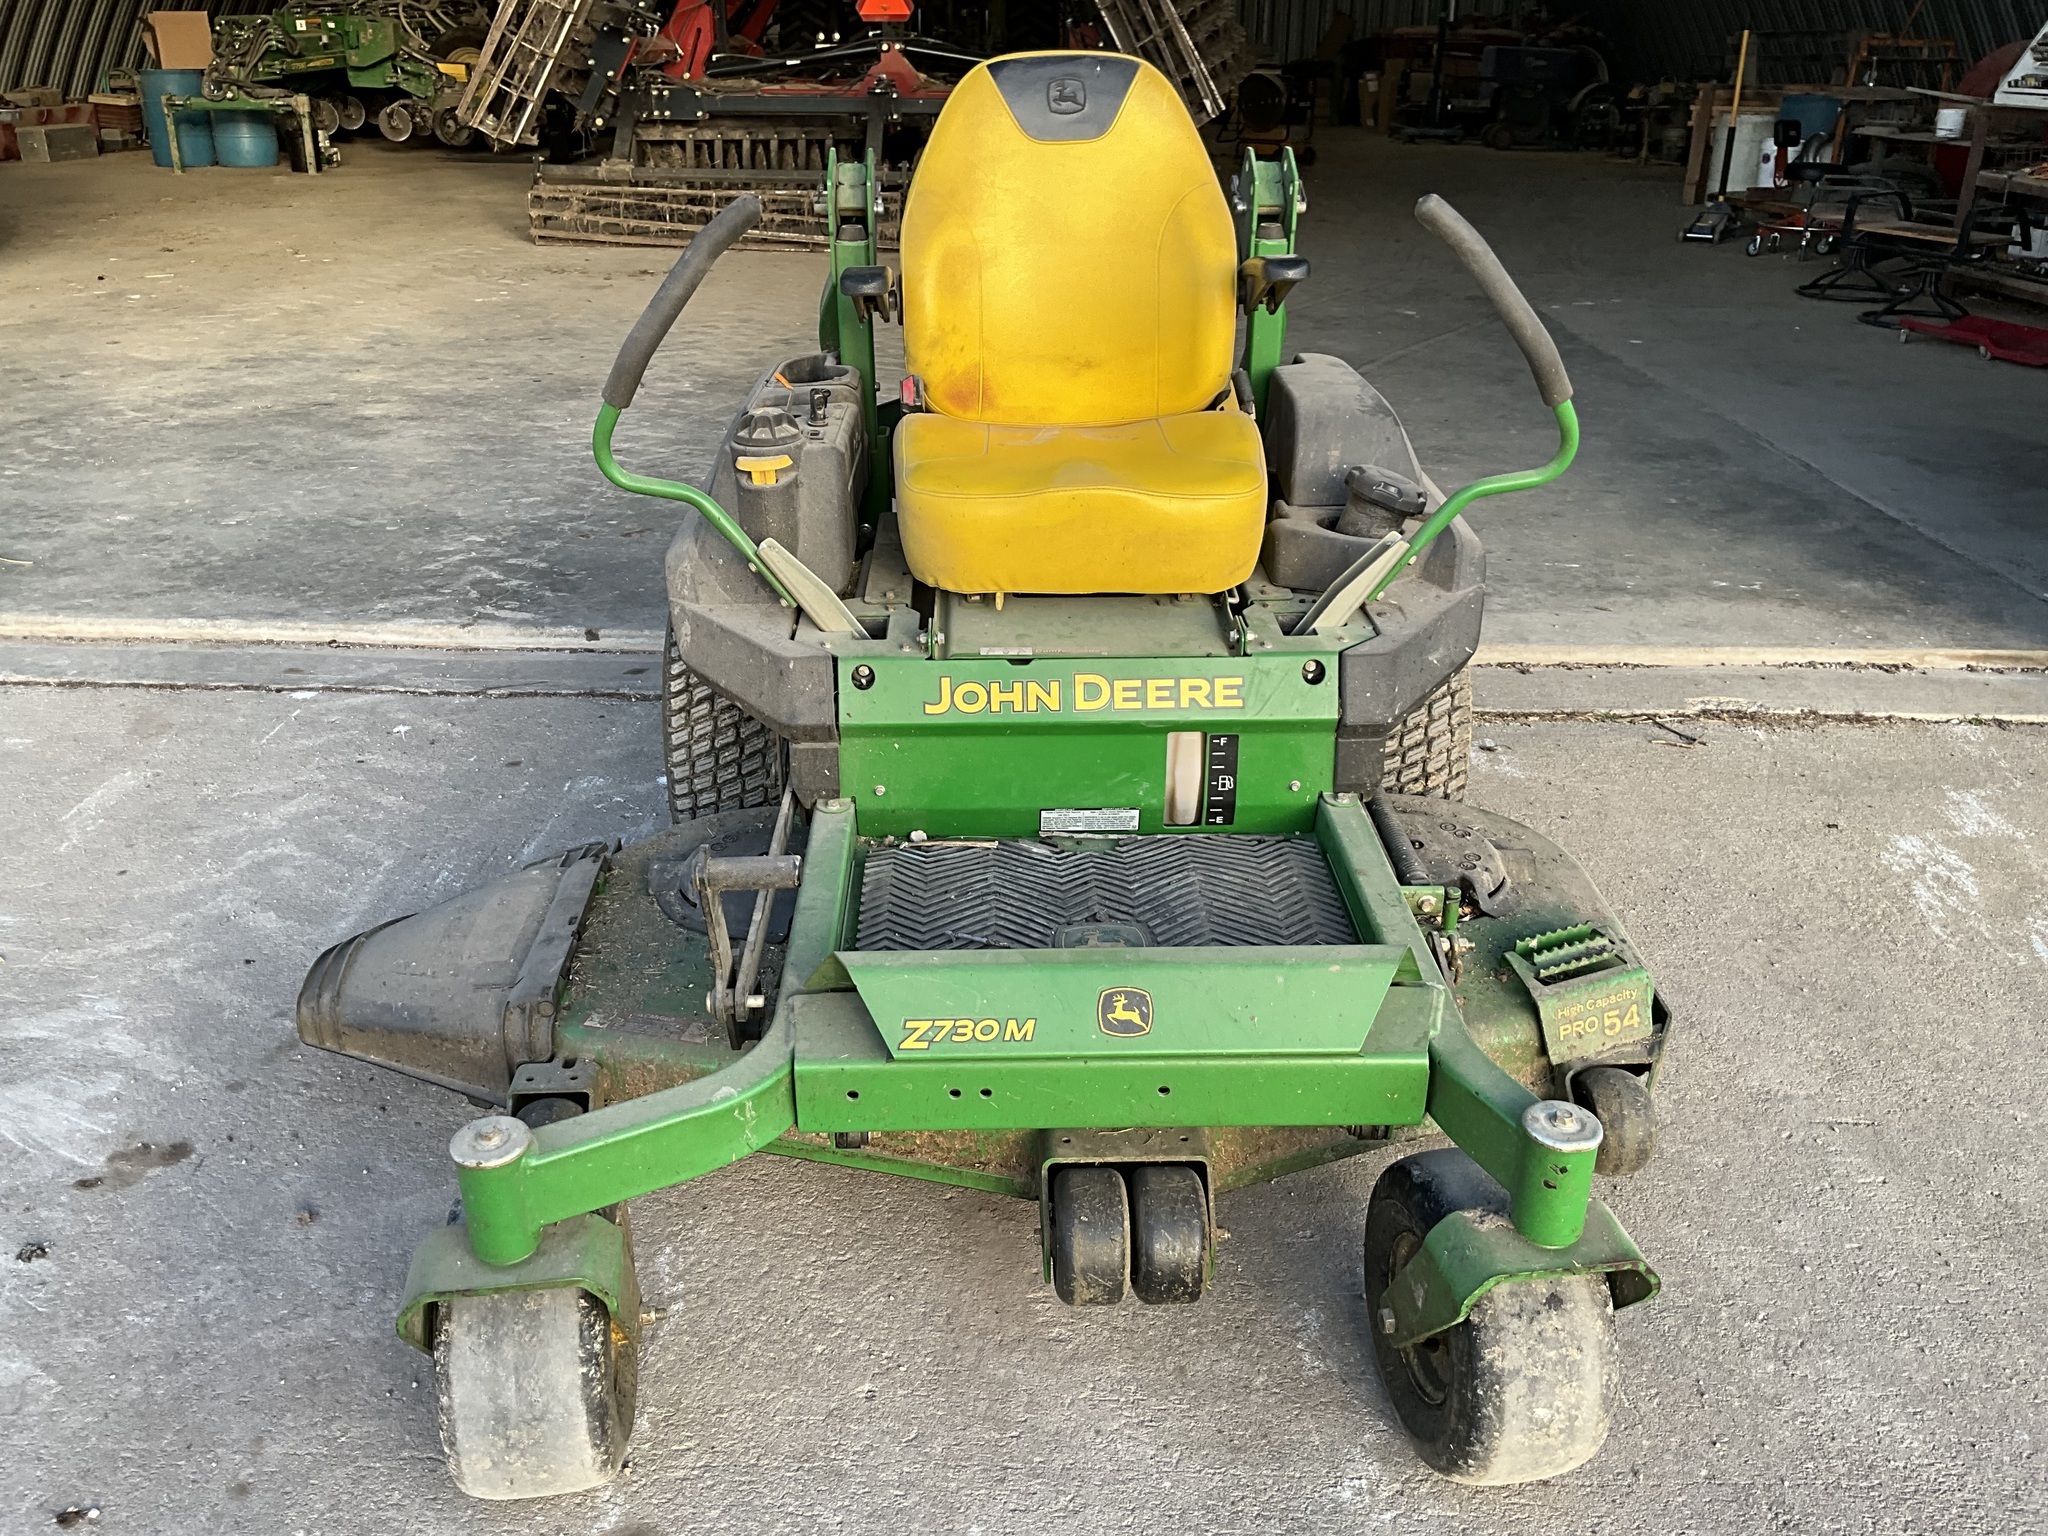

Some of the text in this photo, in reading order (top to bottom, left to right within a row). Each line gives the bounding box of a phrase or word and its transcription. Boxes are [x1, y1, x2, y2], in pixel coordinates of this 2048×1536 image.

[923, 672, 1245, 715] JOHN DEERE
[1220, 737, 1228, 746] F
[1215, 816, 1224, 824] E
[1557, 988, 1638, 1019] High Capacity
[1559, 1004, 1641, 1041] PRO 54
